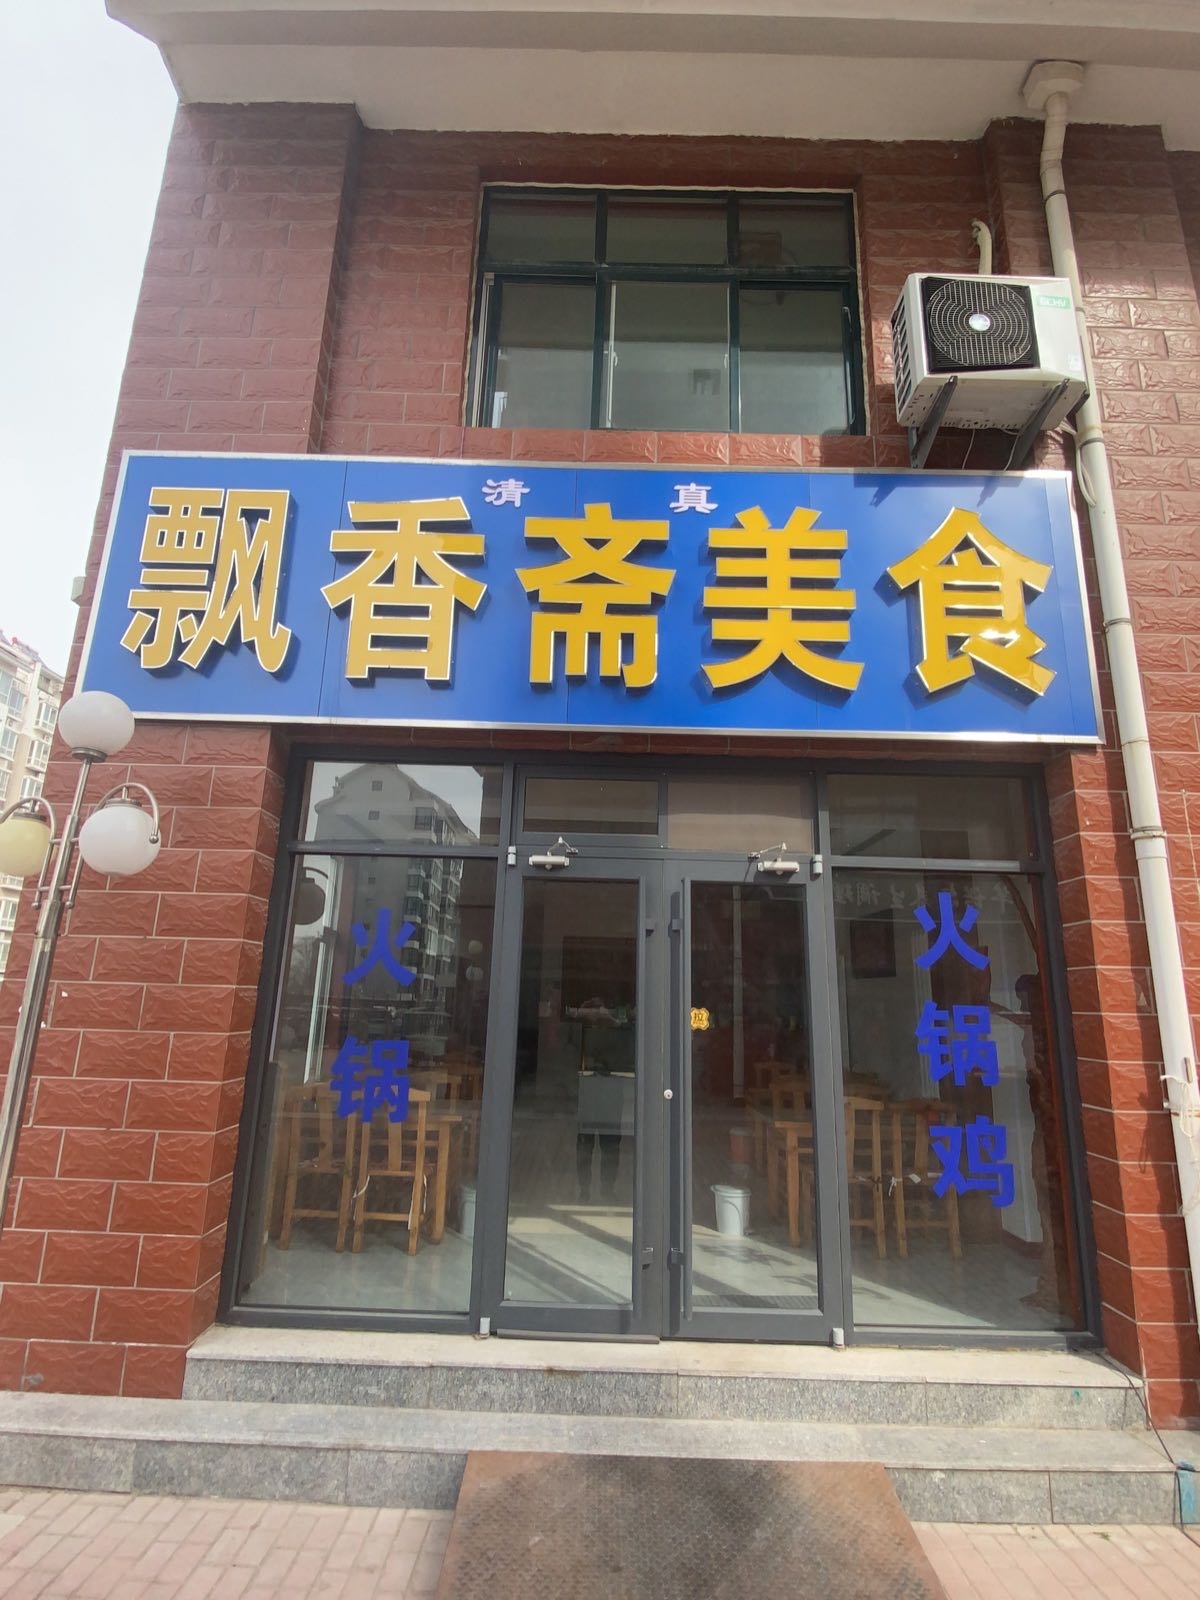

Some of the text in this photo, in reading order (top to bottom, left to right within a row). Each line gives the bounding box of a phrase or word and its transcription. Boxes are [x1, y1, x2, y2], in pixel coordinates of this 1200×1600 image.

[119, 486, 1058, 697] 飘香斋美食
[481, 477, 719, 514] 清 真
[329, 906, 417, 1125] 火锅
[912, 890, 1016, 1209] 火锅鸡
